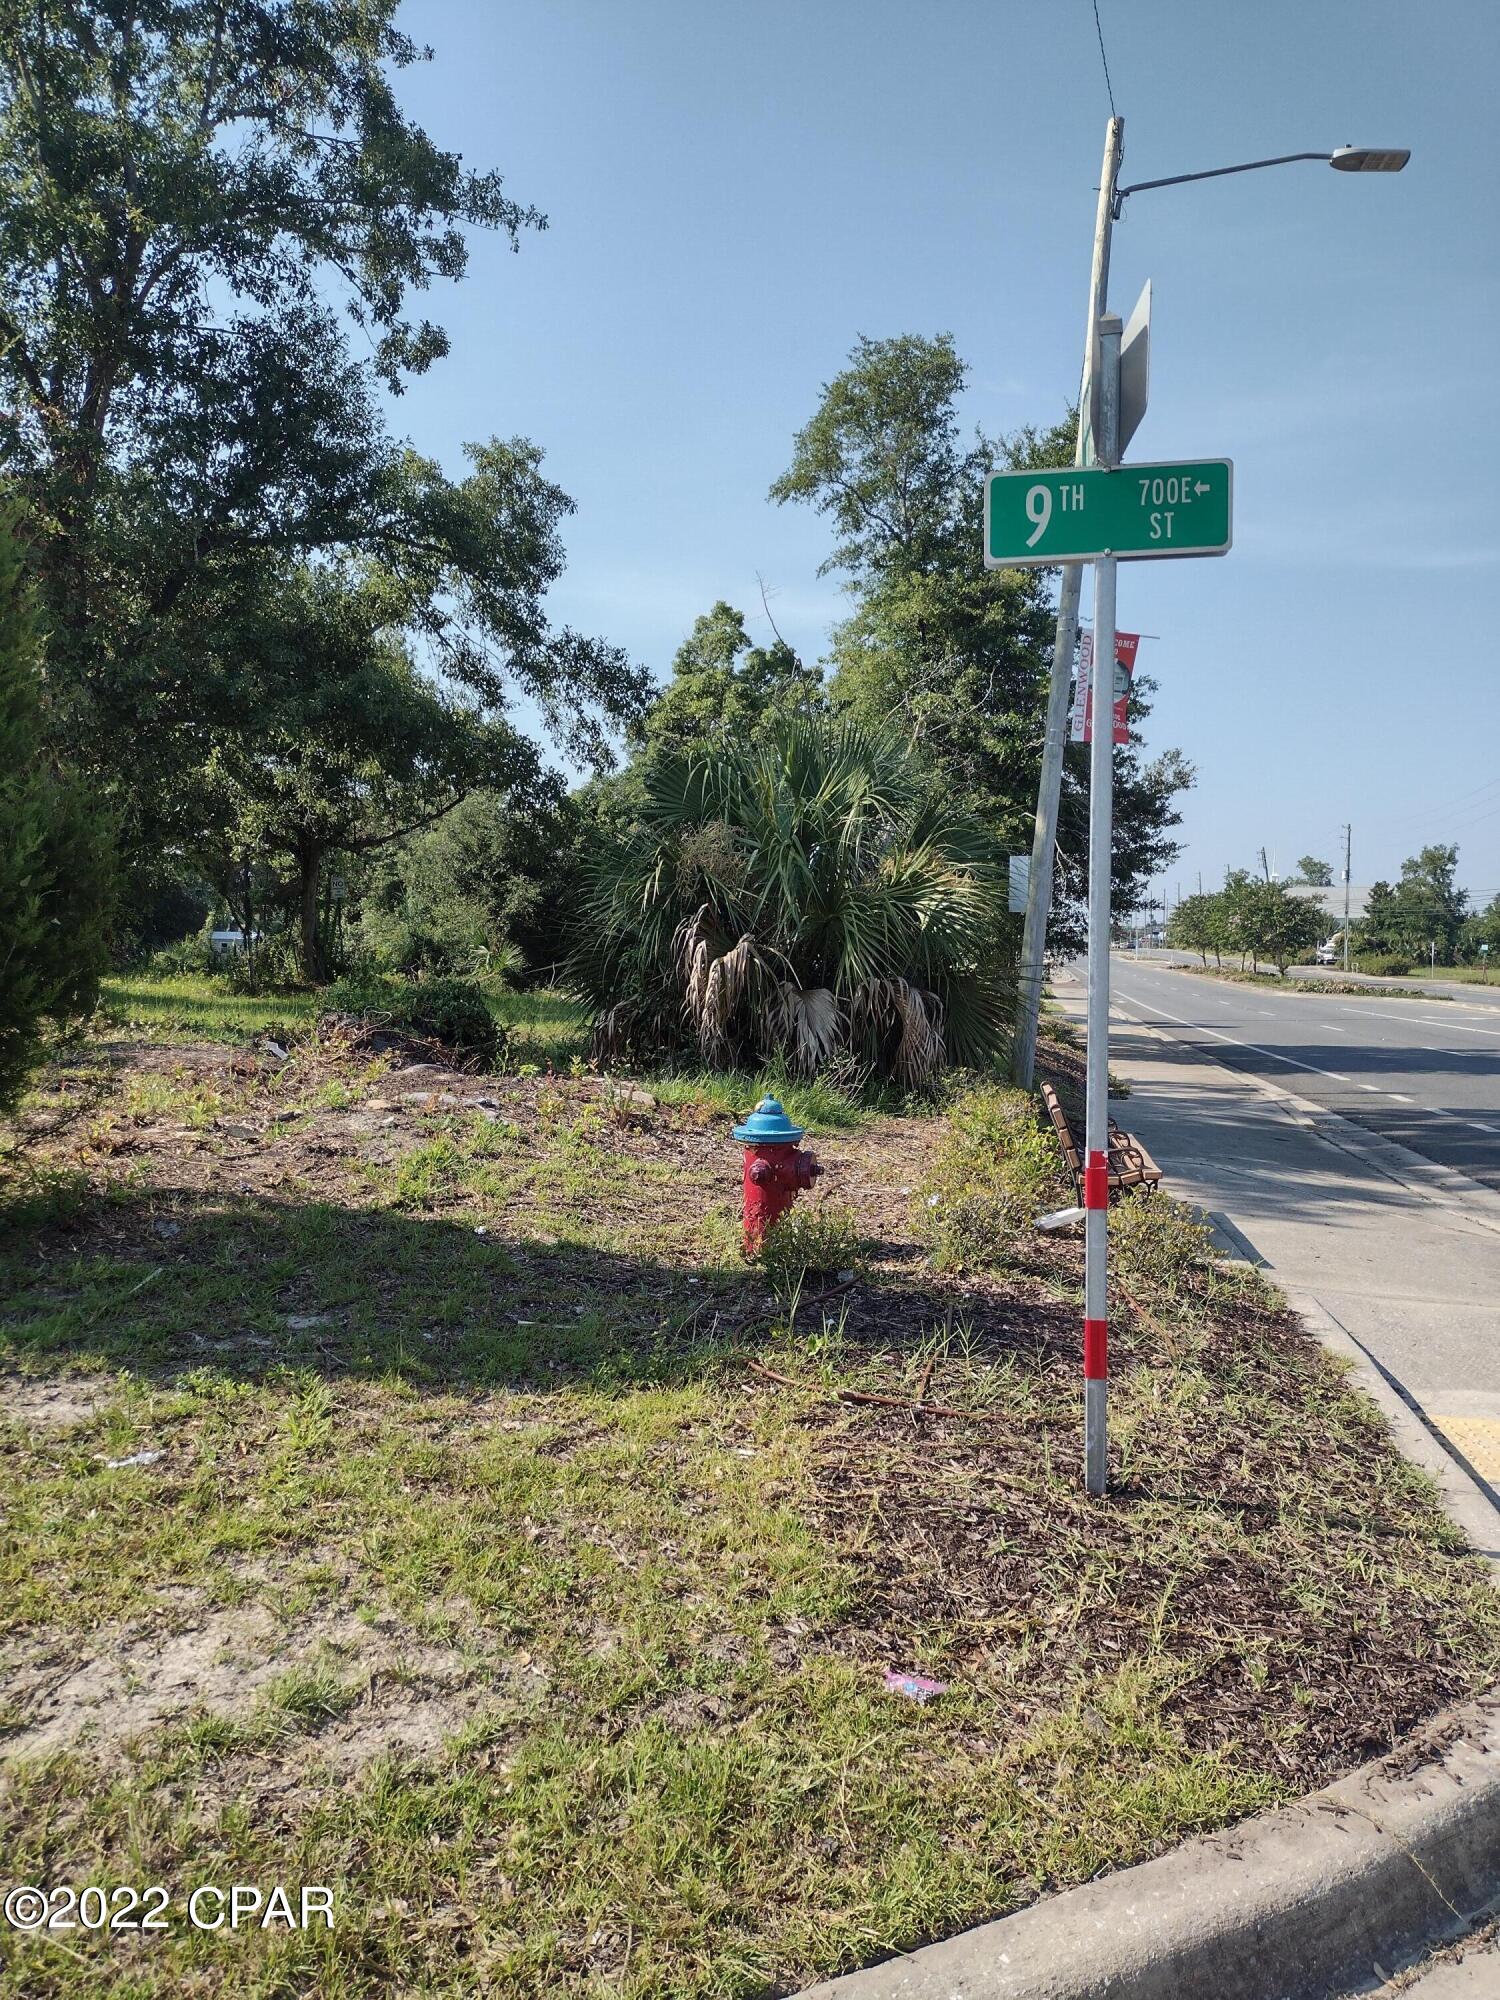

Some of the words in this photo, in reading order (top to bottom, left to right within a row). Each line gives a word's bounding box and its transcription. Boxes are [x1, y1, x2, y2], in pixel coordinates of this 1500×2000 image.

[1138, 477, 1192, 506] 700E
[1149, 512, 1174, 539] ST
[1074, 635, 1092, 731] GLENWOOD
